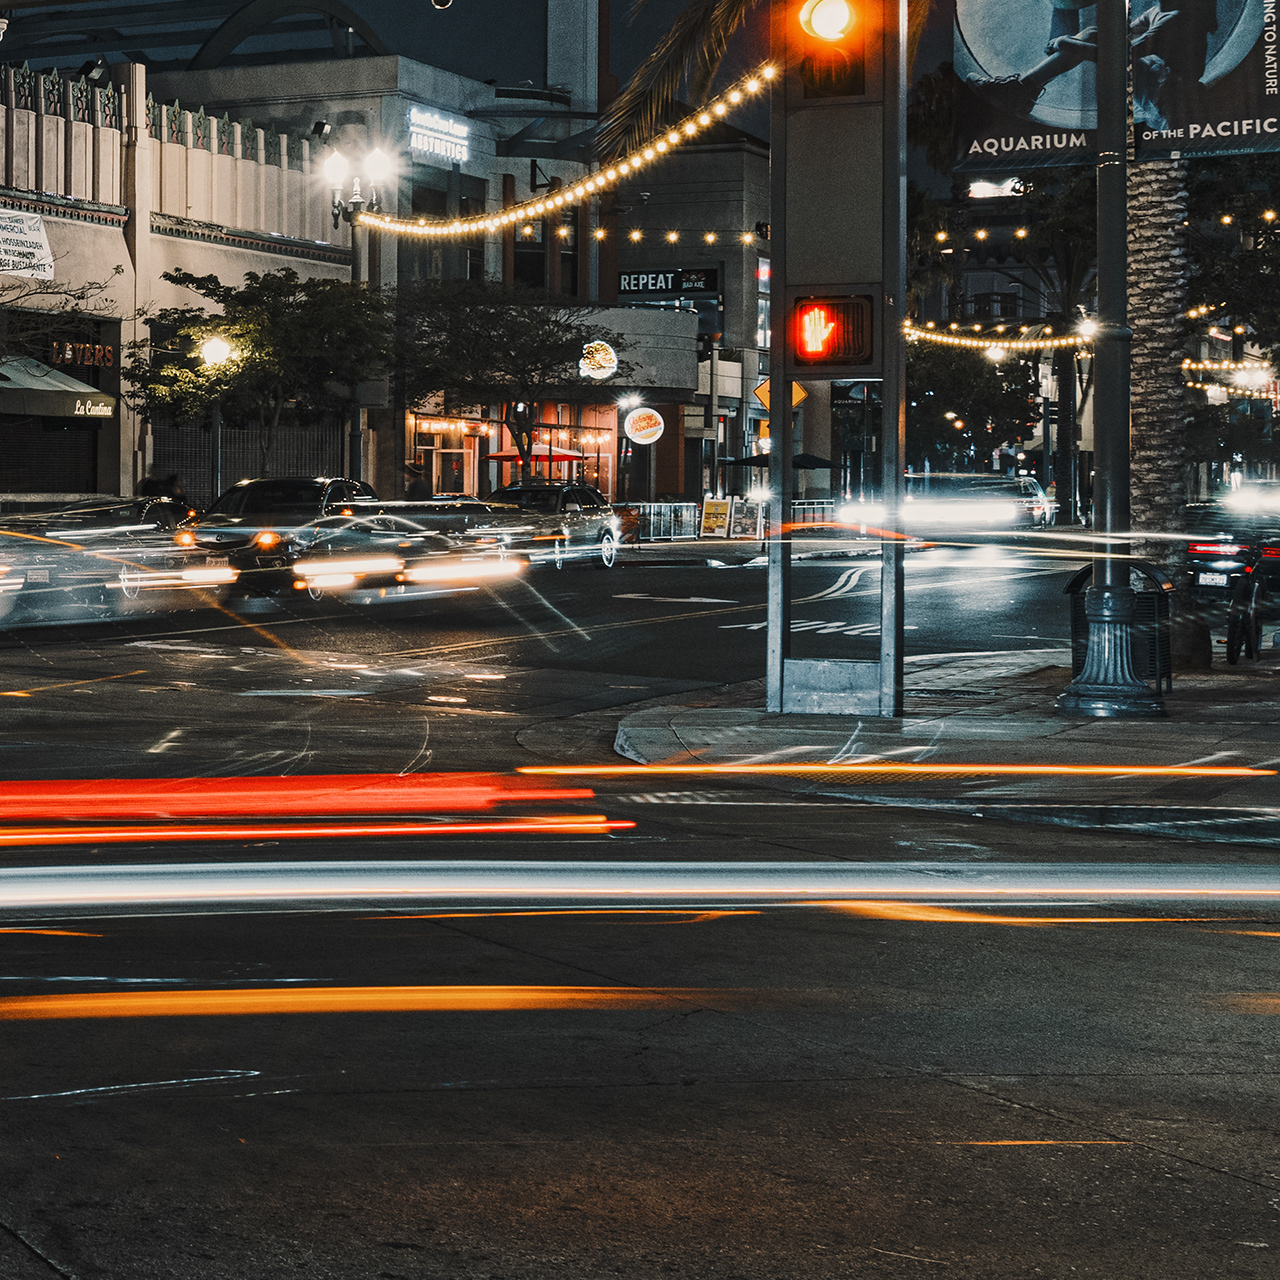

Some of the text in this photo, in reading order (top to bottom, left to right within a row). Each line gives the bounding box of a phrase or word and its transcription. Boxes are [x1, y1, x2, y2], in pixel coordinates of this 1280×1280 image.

[1264, 25, 1277, 42] TO
[1264, 45, 1278, 95] NATURE
[1142, 117, 1279, 141] OF THE PACIFIC
[968, 132, 1087, 156] AQUARIUM
[621, 273, 674, 290] REPEAT
[682, 281, 693, 289] BAD
[52, 341, 114, 367] LOVERS
[74, 400, 112, 416] La Cantina
